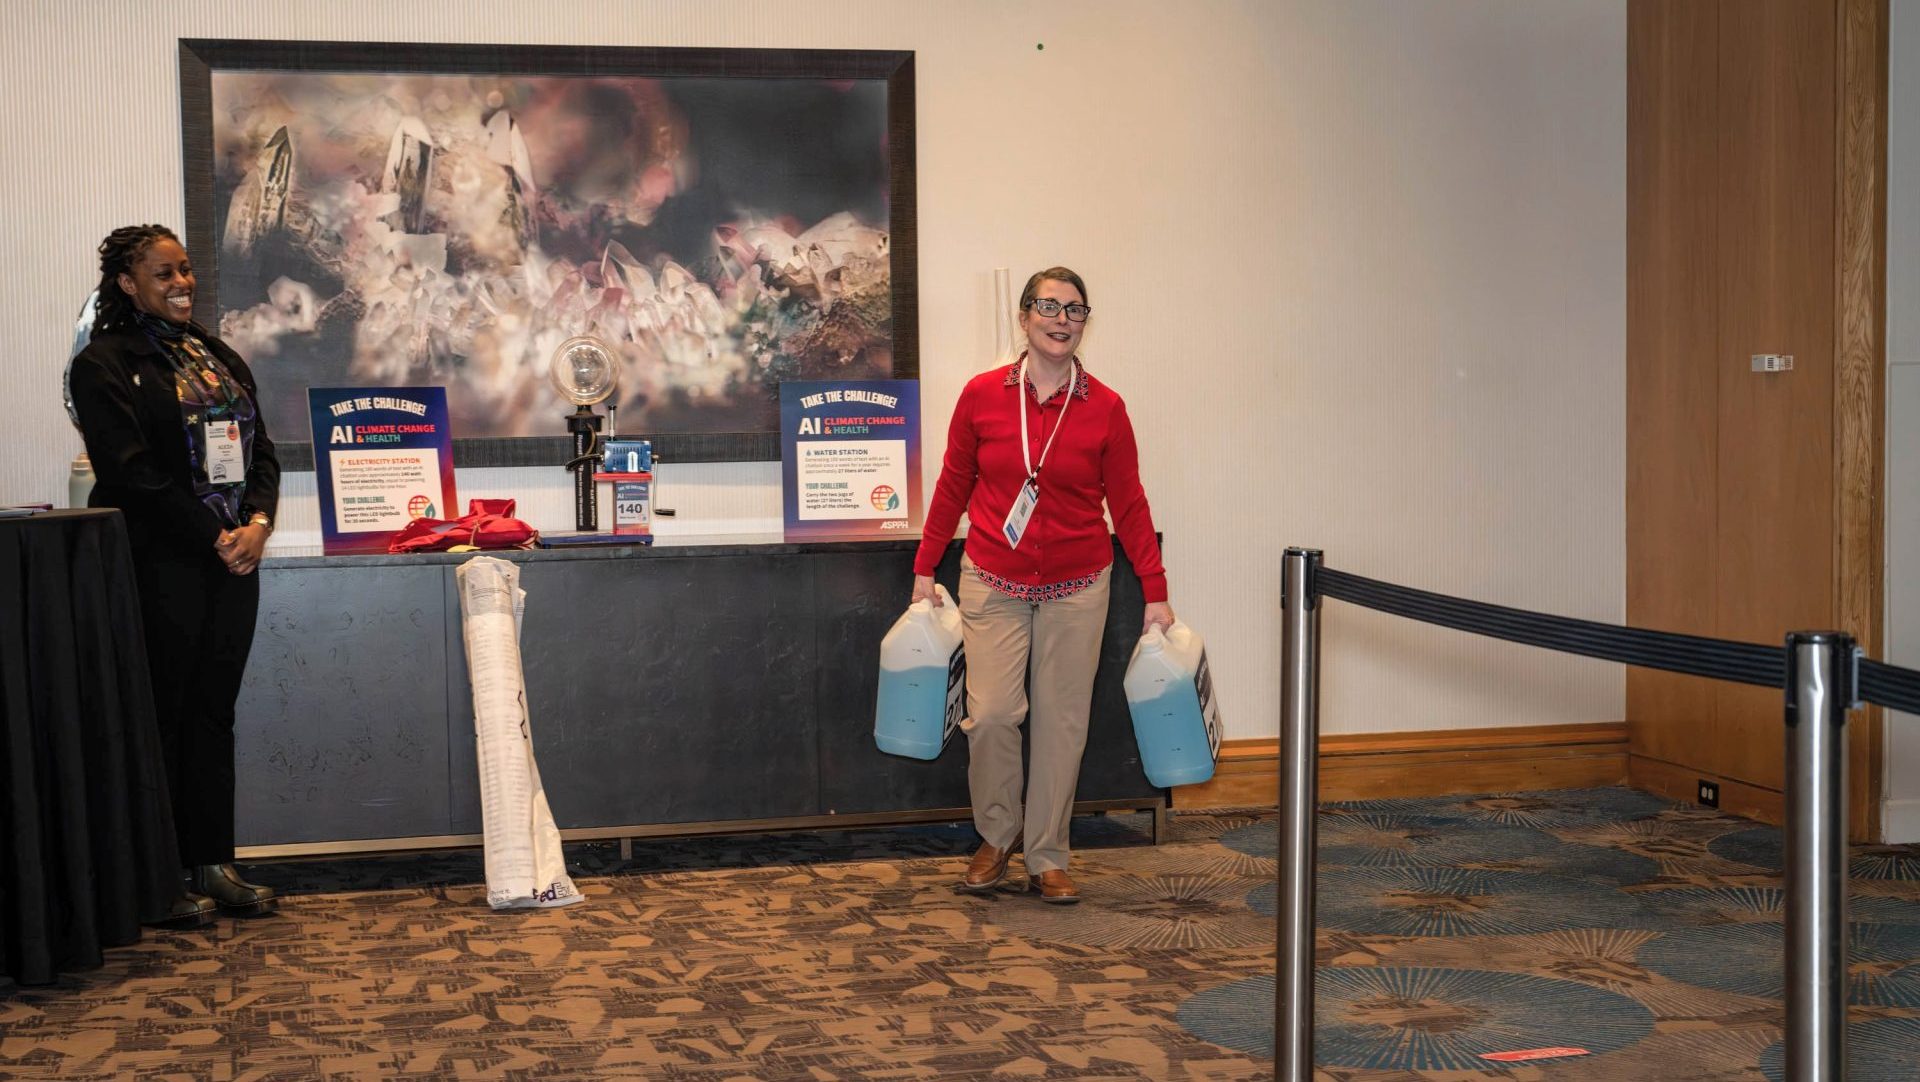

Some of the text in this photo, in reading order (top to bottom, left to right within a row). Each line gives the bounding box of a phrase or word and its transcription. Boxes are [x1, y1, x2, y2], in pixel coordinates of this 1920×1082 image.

[800, 390, 897, 408] TAKE THE CHALLENGE!
[330, 397, 427, 416] TAKE THE CHALLENGE!
[798, 417, 821, 434] AI
[824, 416, 905, 425] CLIMATE CHANGE
[355, 424, 435, 433] CLIMATE CHANGE
[824, 425, 868, 434] & HEALTH
[330, 425, 353, 443] AI
[356, 434, 400, 443] & HEALTH
[618, 503, 642, 514] 140
[880, 521, 908, 529] ASPPH
